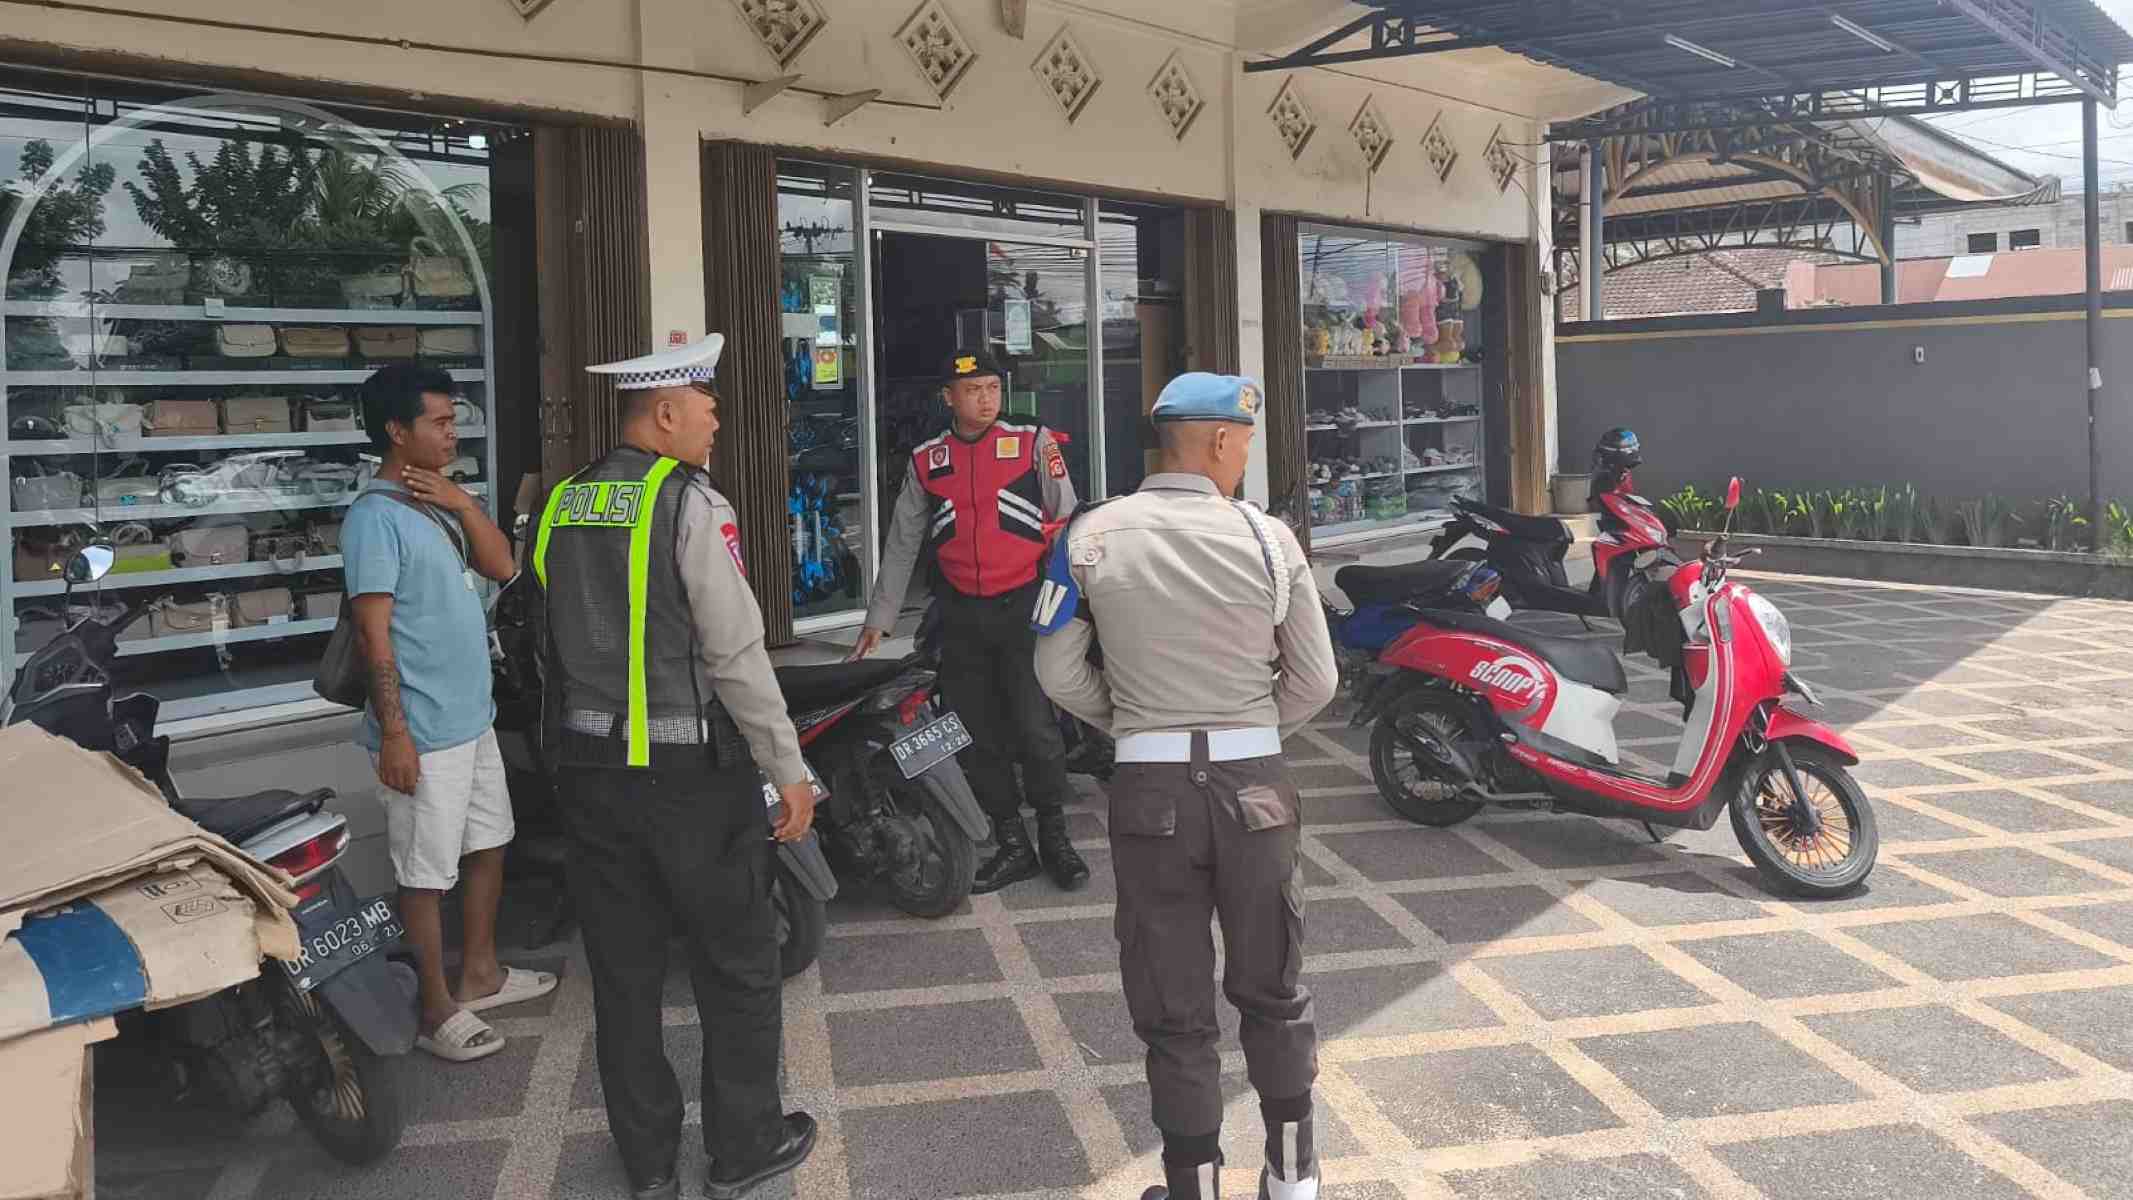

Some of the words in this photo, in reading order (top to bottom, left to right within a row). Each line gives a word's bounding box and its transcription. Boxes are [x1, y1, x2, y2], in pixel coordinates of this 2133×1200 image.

[553, 484, 642, 522] POLISI
[1469, 660, 1548, 700] SCOOPY
[895, 741, 914, 761] DR
[912, 725, 943, 750] 3665
[942, 716, 960, 734] CS
[313, 917, 362, 957] 6023
[361, 900, 392, 929] MB
[351, 941, 370, 956] 06
